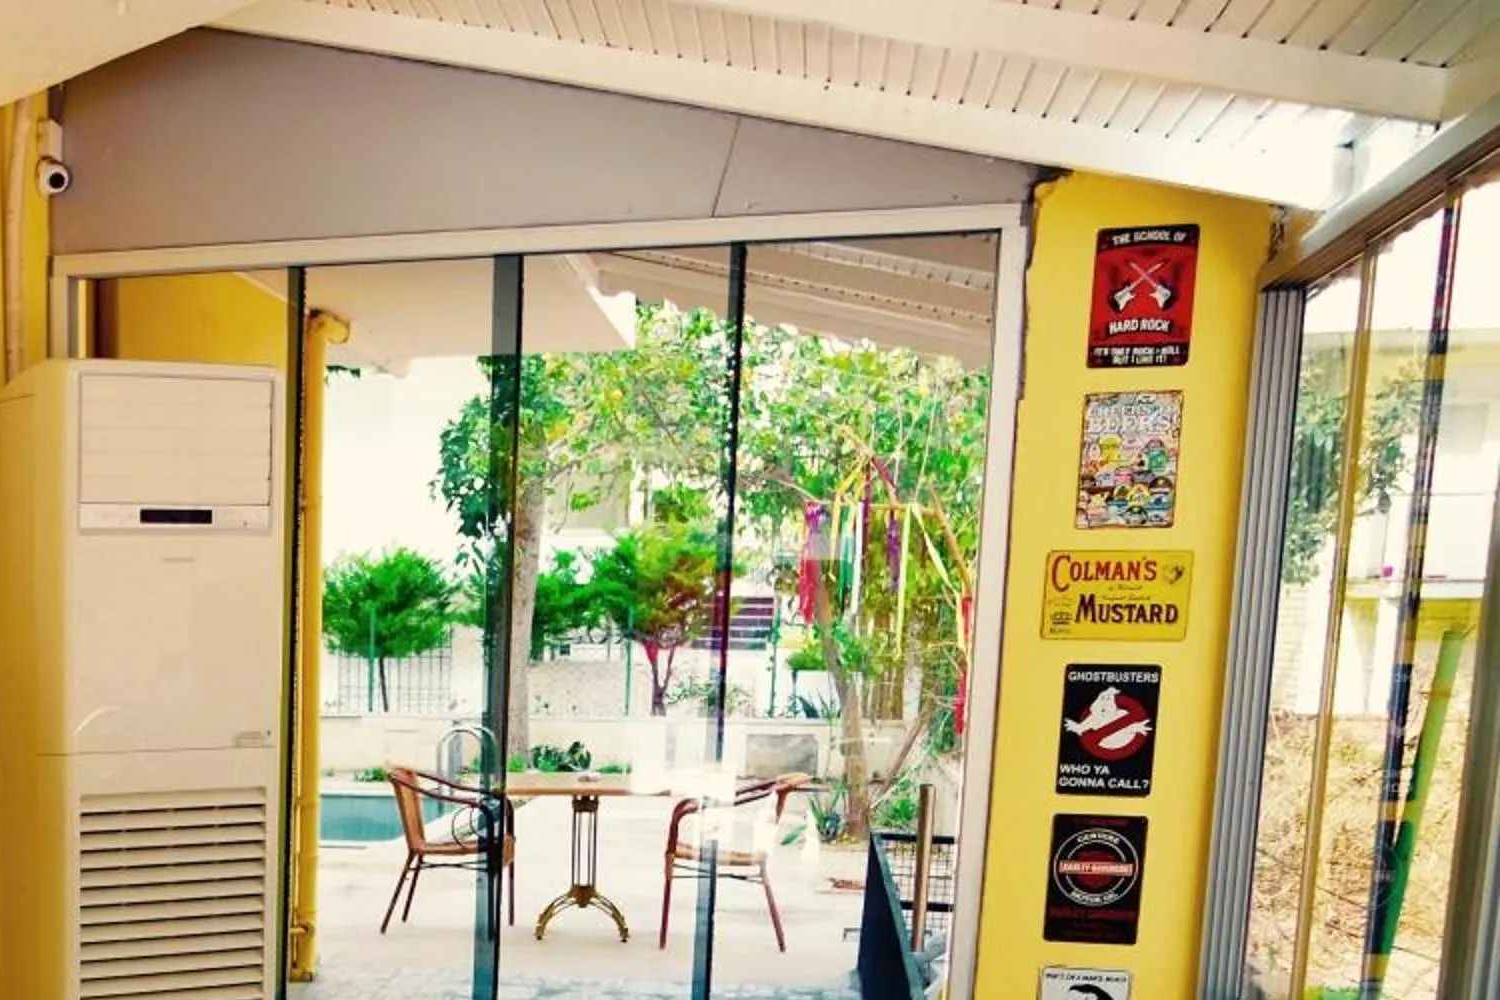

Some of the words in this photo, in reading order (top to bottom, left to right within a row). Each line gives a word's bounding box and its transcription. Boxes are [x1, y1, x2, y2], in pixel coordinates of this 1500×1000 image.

[1109, 320, 1138, 335] HARD
[1140, 318, 1169, 332] ROCK
[1052, 555, 1157, 593] COLMAN'S
[1075, 594, 1179, 623] MUSTARD
[1068, 671, 1158, 682] GHOSTBUSTERS
[1060, 764, 1091, 774] WHO
[1094, 765, 1110, 775] YA
[1059, 776, 1105, 788] GONNA
[1107, 779, 1149, 789] CALL?
